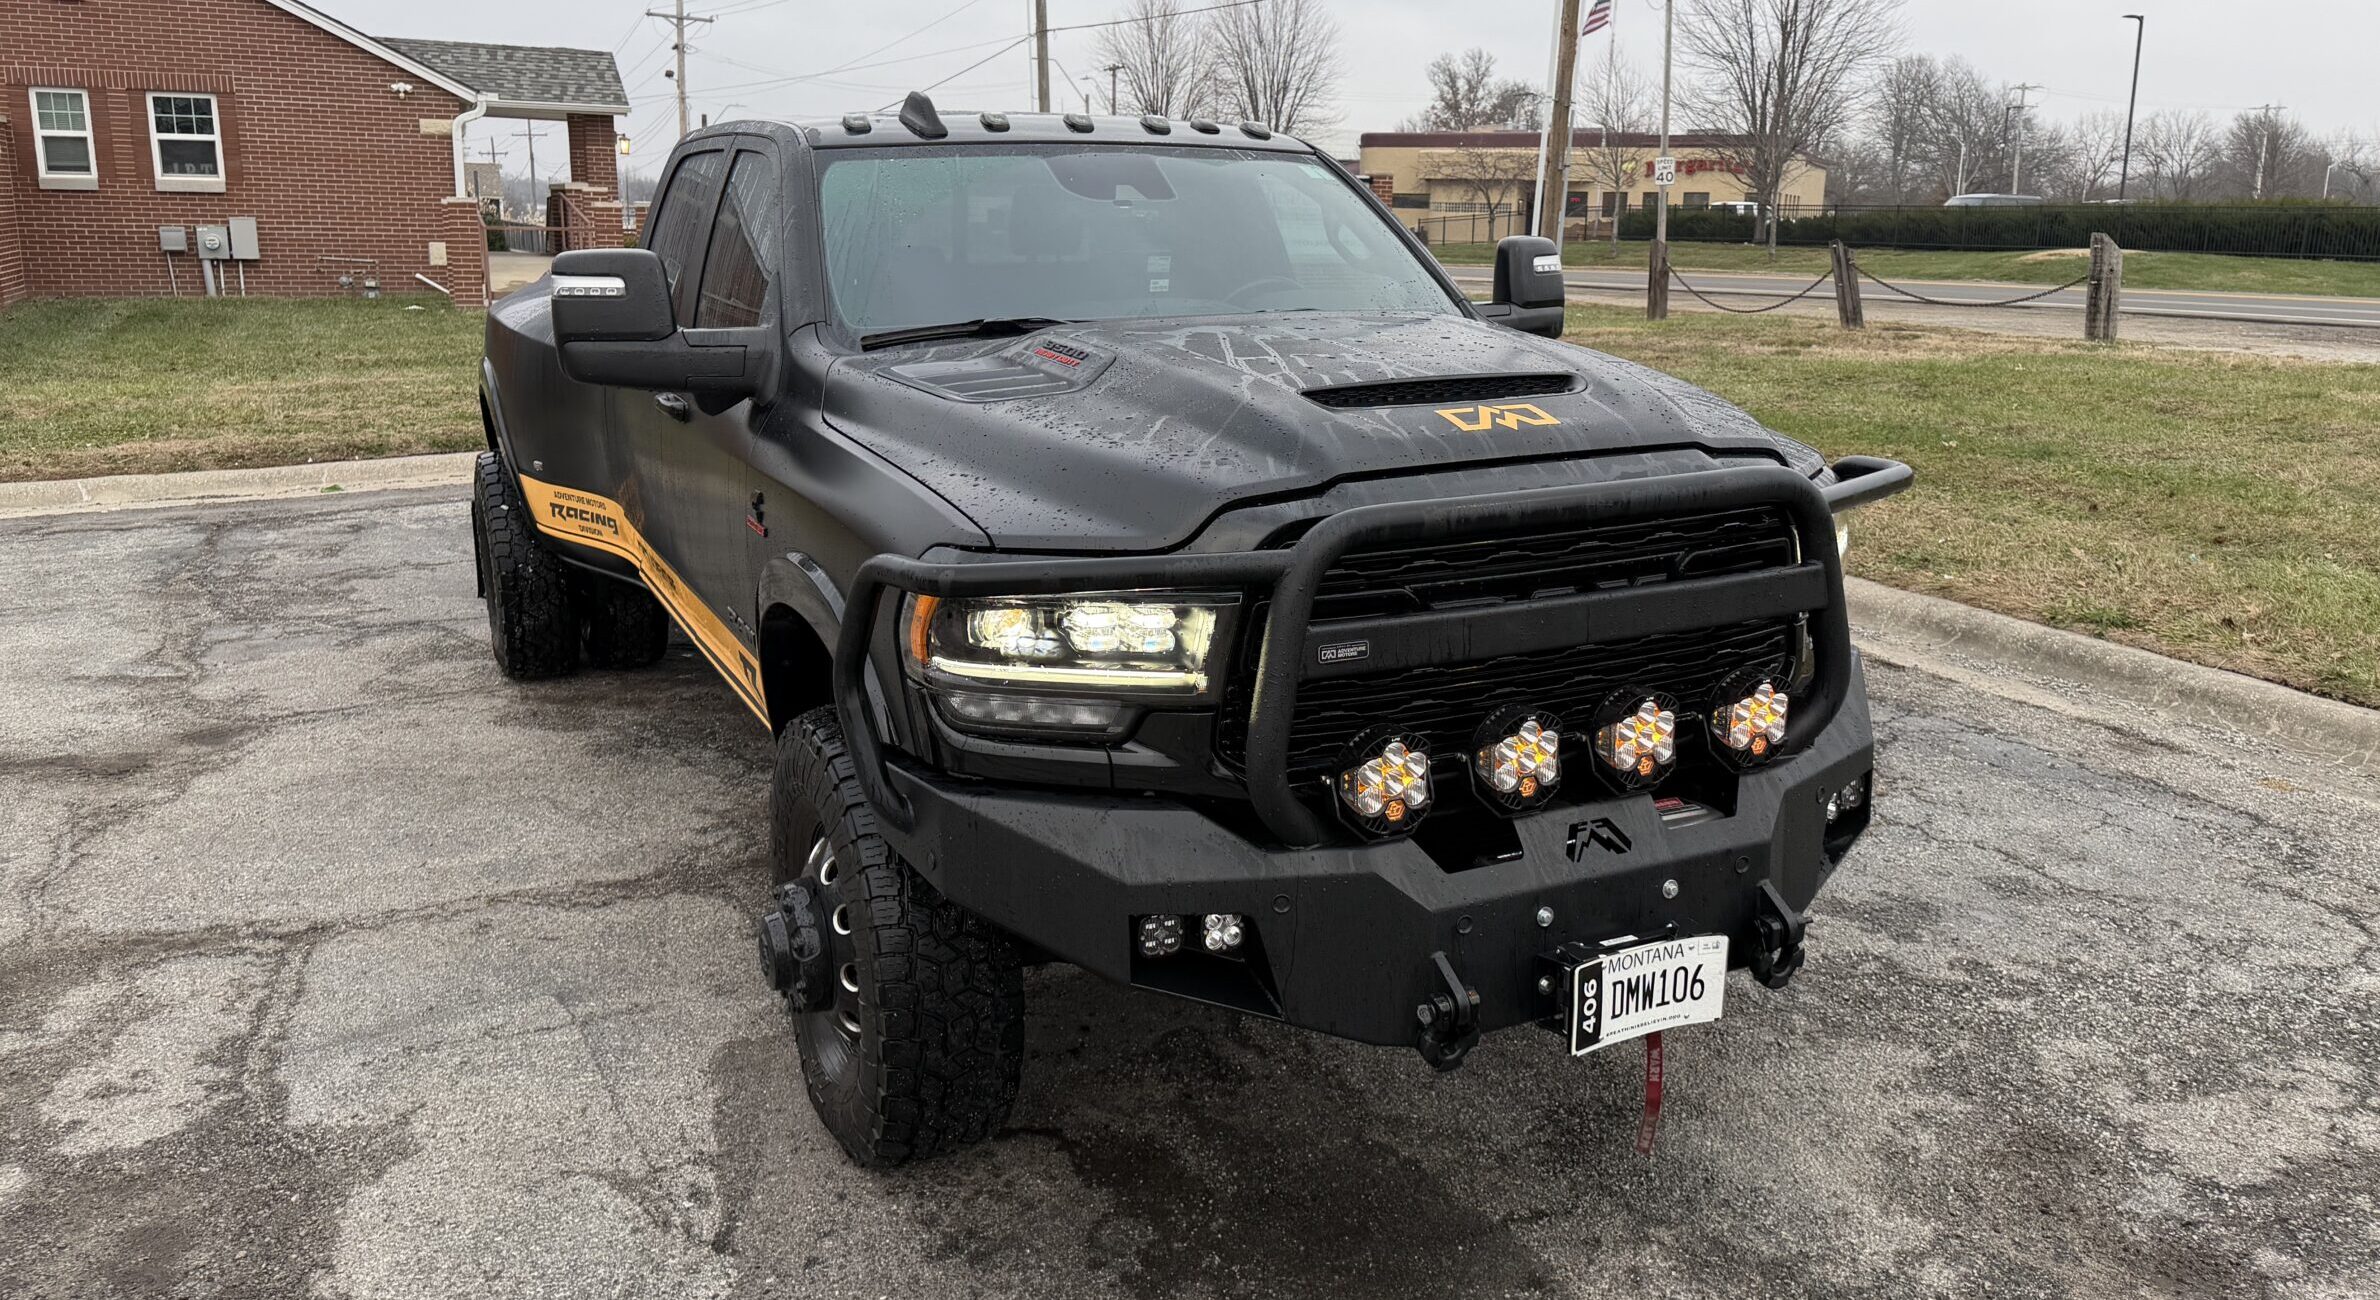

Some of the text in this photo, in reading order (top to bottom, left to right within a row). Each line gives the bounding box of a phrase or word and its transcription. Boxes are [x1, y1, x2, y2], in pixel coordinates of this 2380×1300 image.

[1656, 171, 1674, 182] 40
[553, 490, 586, 505] ADVENTURE
[1337, 645, 1367, 654] ADVENTURE
[1608, 943, 1685, 975] MONTANA
[1610, 963, 1705, 1020] DMW106
[1582, 978, 1598, 1034] 406
